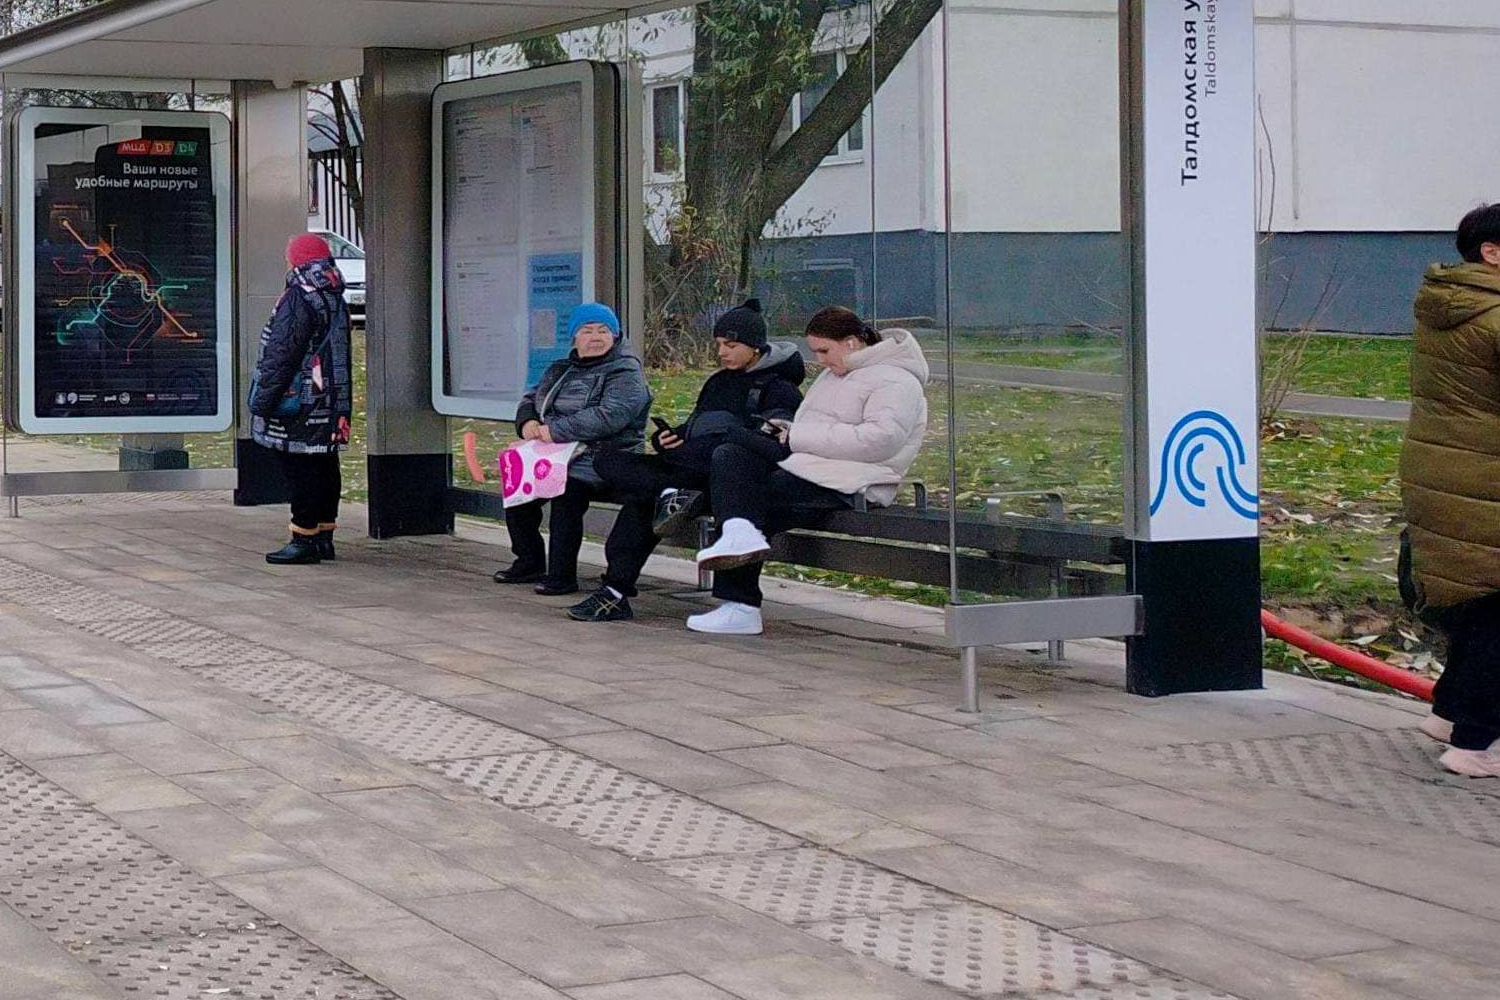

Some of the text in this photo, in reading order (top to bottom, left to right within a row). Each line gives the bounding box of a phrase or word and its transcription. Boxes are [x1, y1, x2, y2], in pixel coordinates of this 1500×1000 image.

[1181, 20, 1200, 186] Талдомская
[121, 142, 147, 152] МЦД
[123, 162, 198, 176] Ваши новые
[75, 175, 198, 191] удобные маршруты
